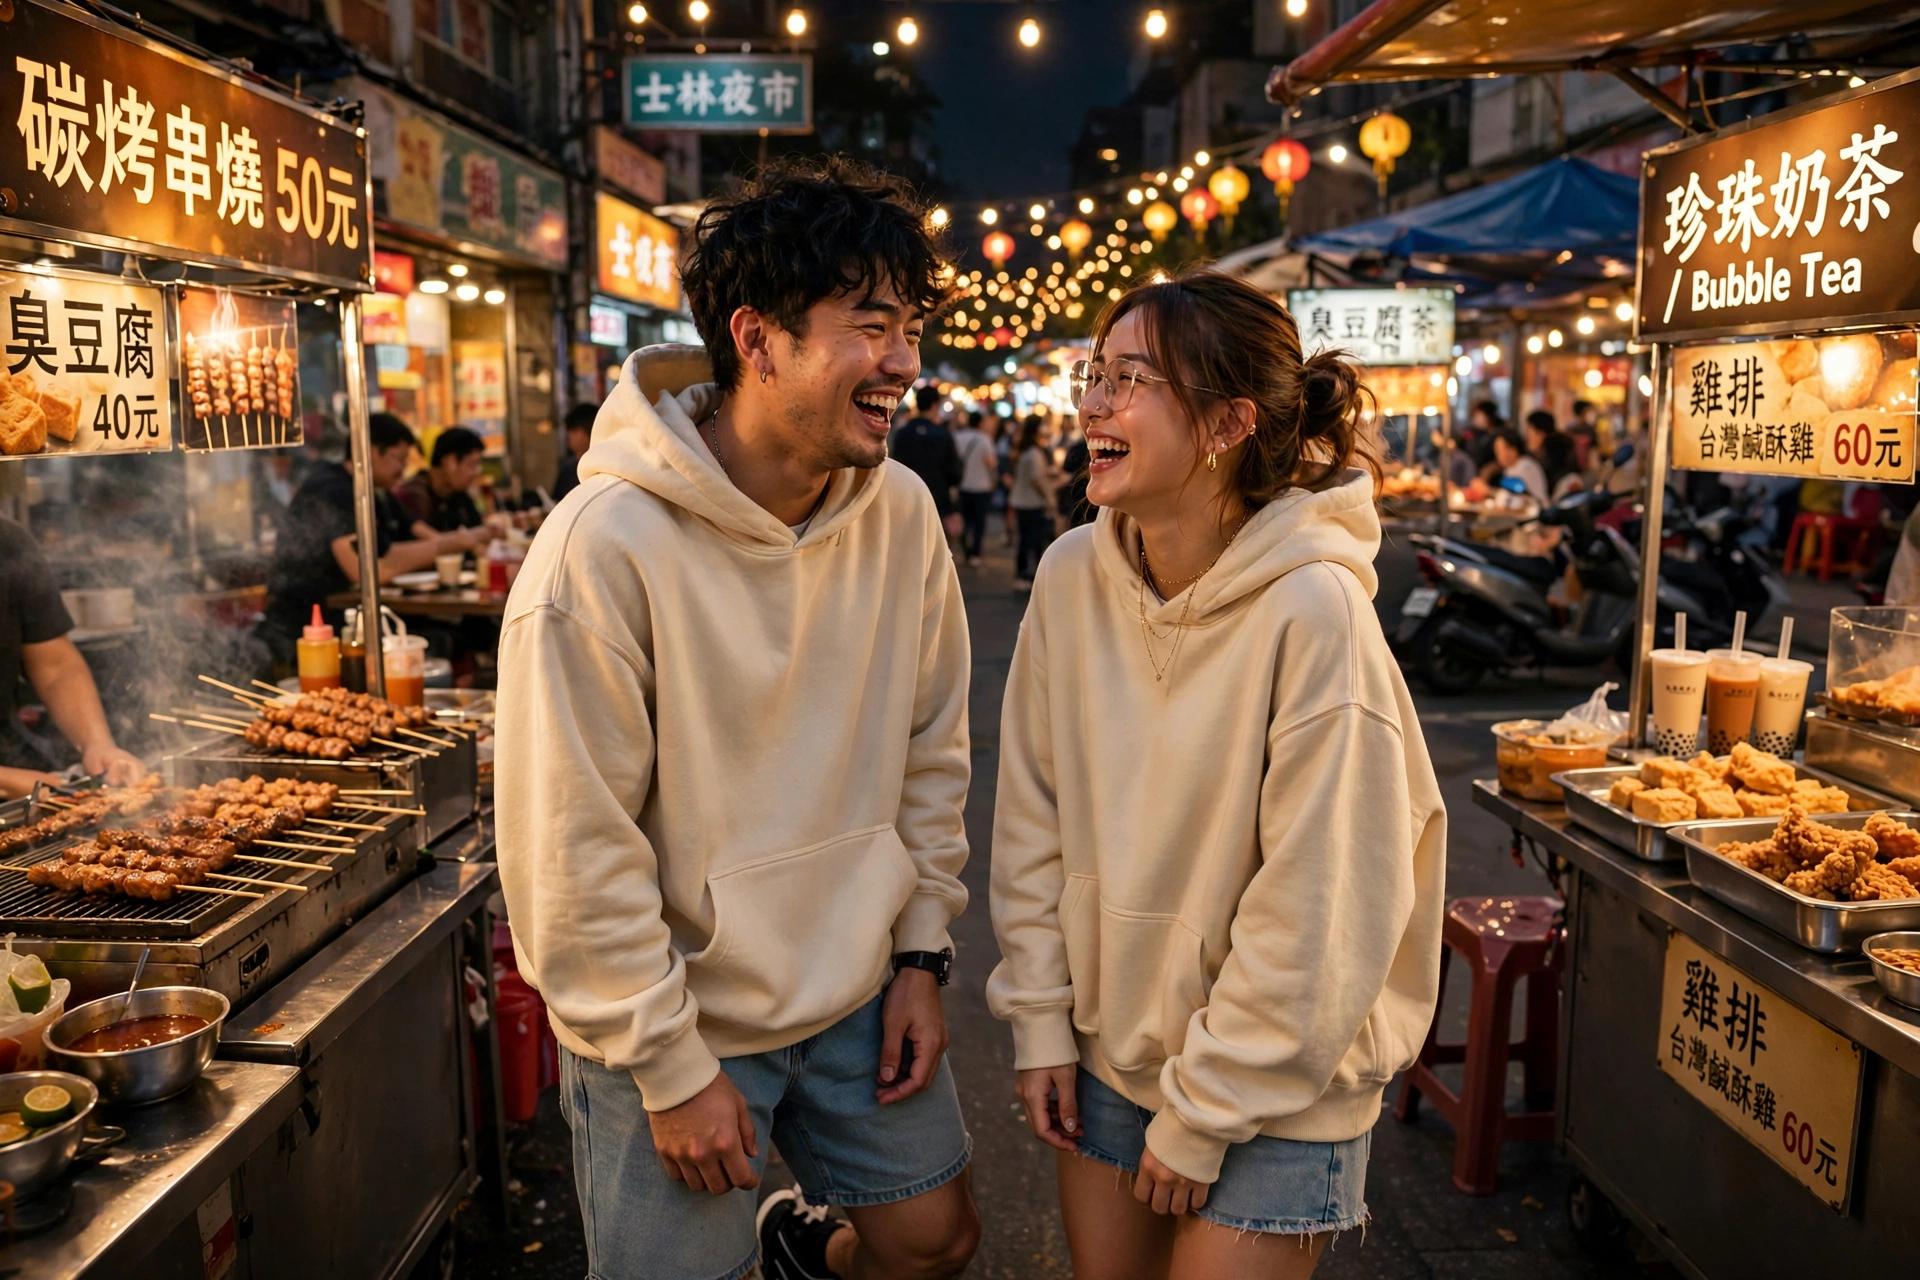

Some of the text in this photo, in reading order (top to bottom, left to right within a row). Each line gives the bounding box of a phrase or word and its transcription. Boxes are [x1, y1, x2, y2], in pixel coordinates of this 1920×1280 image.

[634, 69, 799, 117] 士林夜市
[16, 55, 265, 229] 碳烤串燒
[276, 146, 359, 250] 50元
[1663, 123, 1904, 264] 珍珠奶茶
[1691, 257, 1791, 312] Bubble
[1800, 251, 1862, 298] Tea
[5, 288, 154, 379] 臭豆腐
[93, 393, 159, 440] 40元
[1690, 355, 1765, 419] 雞排
[1833, 422, 1902, 468] 60元
[1682, 958, 1767, 1067] 雞排
[1782, 1110, 1838, 1187] 60元
